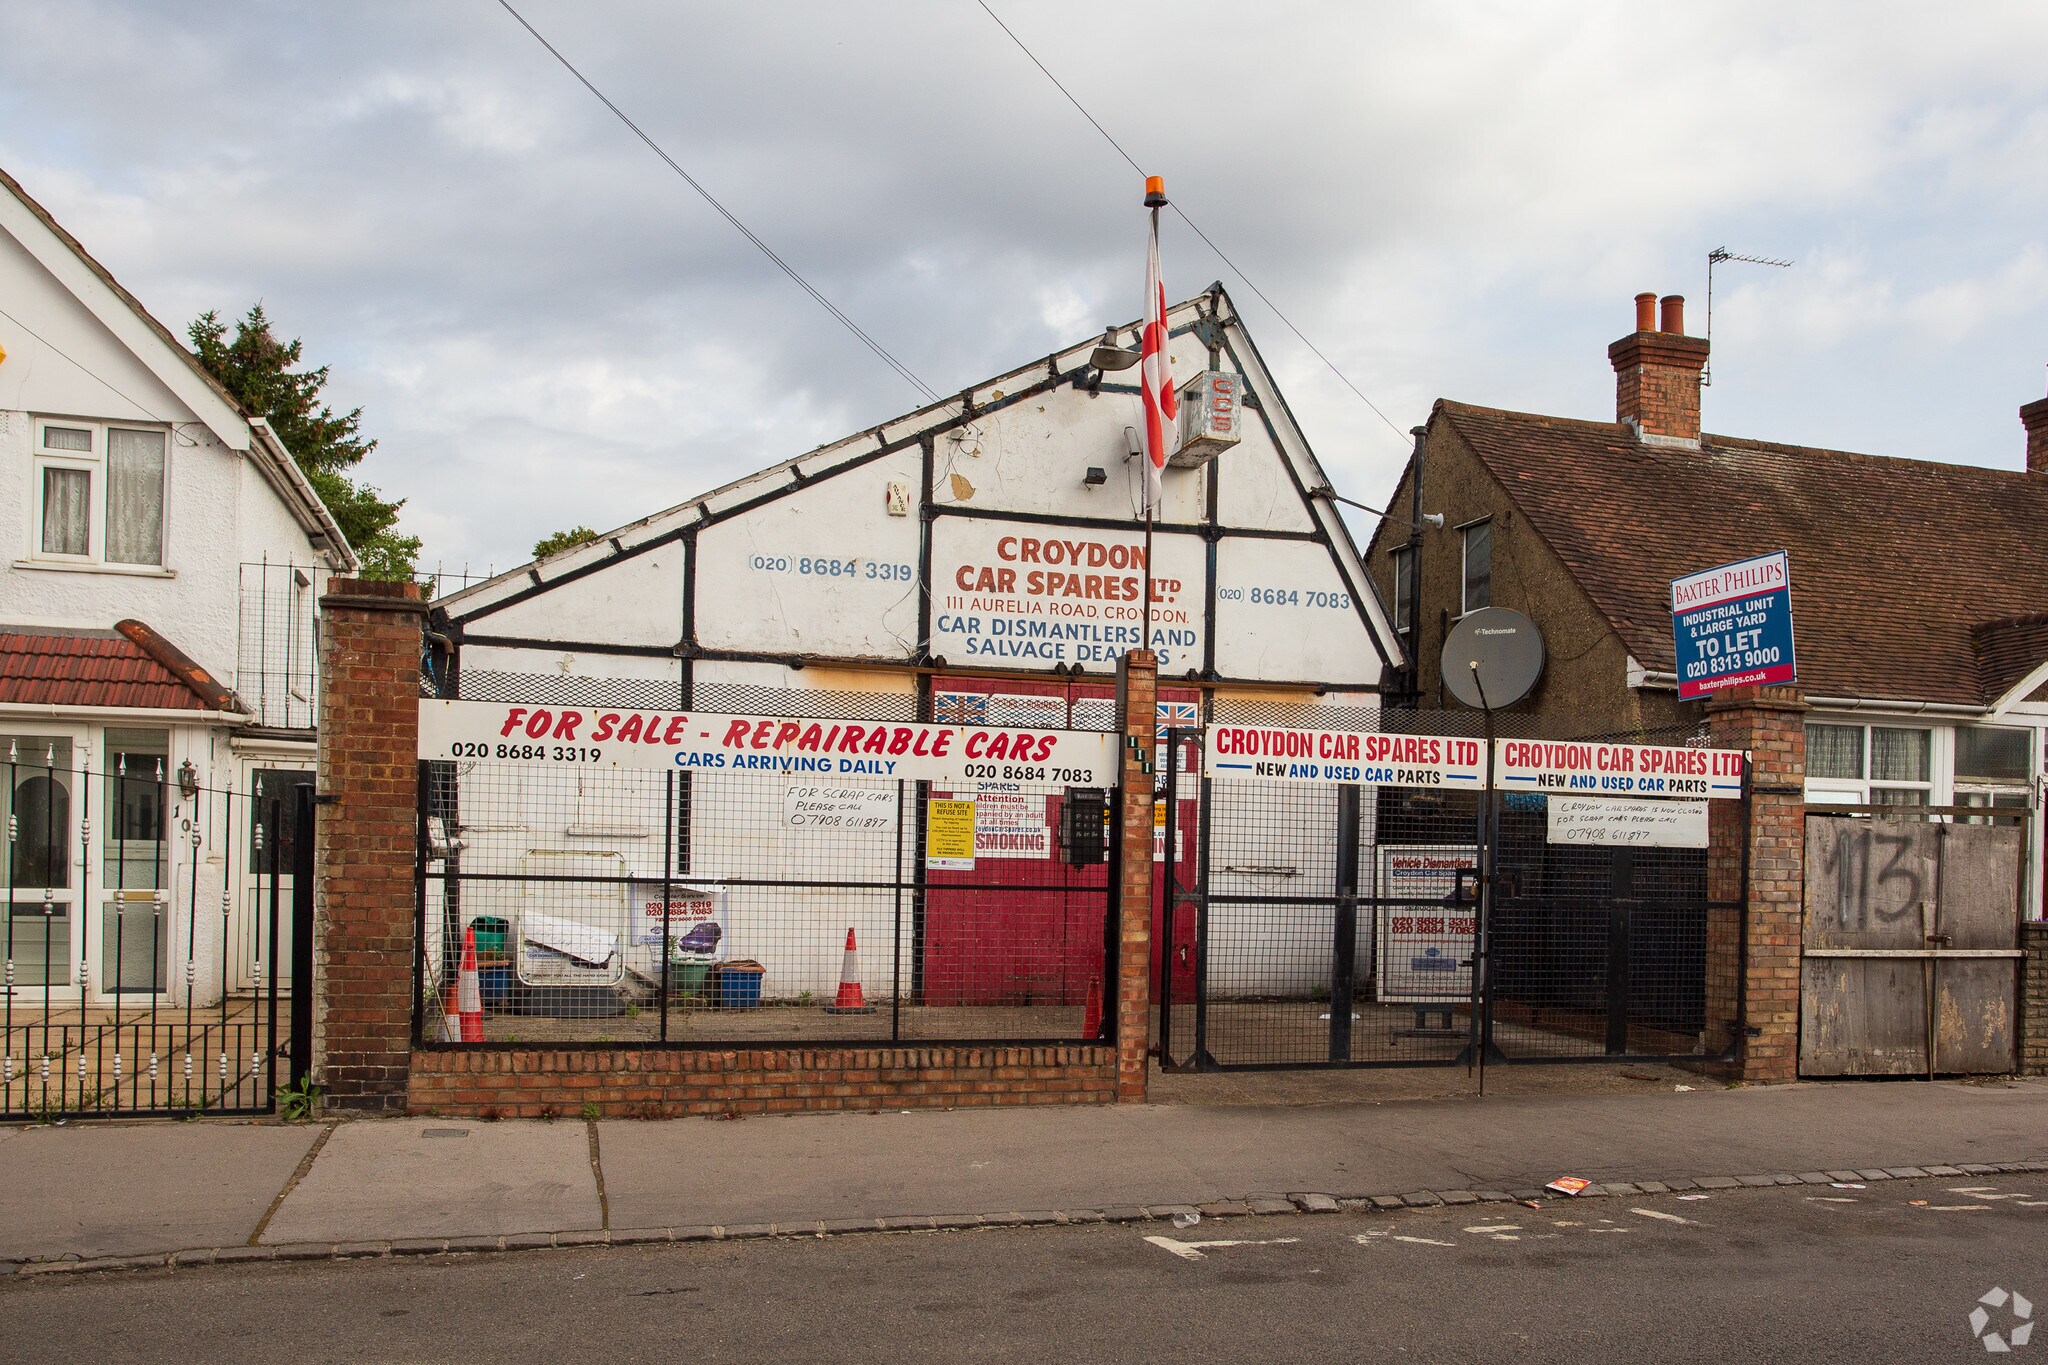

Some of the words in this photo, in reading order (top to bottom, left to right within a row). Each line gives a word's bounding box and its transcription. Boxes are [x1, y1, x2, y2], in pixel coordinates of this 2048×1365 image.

[997, 536, 1146, 570] CROYDON
[749, 553, 793, 574] (020)
[799, 557, 857, 578] 8684
[865, 562, 912, 582] 3319
[955, 565, 1017, 593] CAR
[1026, 570, 1139, 601] SPARES
[946, 595, 964, 610] 111
[970, 598, 1043, 615] AURELIA
[1050, 602, 1100, 619] ROAD,
[1216, 585, 1245, 603] (020)
[1250, 587, 1299, 606] 8684
[1305, 591, 1350, 609] 7083
[1683, 605, 1743, 627] INDUSTRIAL
[1746, 597, 1774, 613] UNIT
[937, 615, 981, 634] CAR
[992, 619, 1141, 644] DISMANTLERS
[1151, 629, 1197, 647] AND
[1690, 627, 1698, 638] &
[1700, 618, 1733, 636] LARGE
[1736, 612, 1767, 628] YARD
[966, 637, 1066, 660] SALVAGE
[1077, 644, 1170, 665] DEAS
[1696, 638, 1719, 659] TO
[1725, 628, 1762, 654] LET
[1687, 660, 1708, 678] 020
[1711, 653, 1741, 673] 8313
[1745, 646, 1779, 667] 9000
[1699, 672, 1766, 691] baxterphilips.co.uk
[500, 708, 583, 741] FOR
[591, 713, 688, 745] SALE
[722, 719, 954, 757] REPAIRABLE
[964, 731, 1058, 762] CARS
[1216, 727, 1313, 759] CROYDON
[1319, 733, 1360, 760] CAR
[1365, 736, 1441, 765] SPARES
[1446, 740, 1479, 766] LTD
[452, 742, 489, 758] 020
[496, 744, 546, 760] 8684
[552, 747, 601, 763] 3319
[674, 751, 726, 768] CARS
[732, 754, 832, 772] ARRIVING
[839, 759, 896, 775] DAILY
[1505, 742, 1592, 771] CROYDON
[1597, 746, 1634, 772] CAR
[1639, 749, 1707, 775] SPARES
[1712, 752, 1742, 776] LTD
[964, 763, 997, 779] 020
[1002, 765, 1046, 781] 8684
[1051, 768, 1093, 783] 7083
[1256, 761, 1287, 777] NEW
[1289, 764, 1318, 779] AND
[1324, 766, 1360, 781] USED
[1365, 768, 1394, 783] CAR
[1397, 769, 1441, 784] PARTS
[1538, 773, 1566, 788] NEW
[1569, 774, 1596, 789] AND
[1601, 776, 1634, 791] USED
[1638, 778, 1665, 791] CAR
[1669, 779, 1707, 793] PARTS
[787, 786, 819, 798] FOR
[822, 788, 865, 800] SCRAP
[866, 793, 895, 803] CARS
[795, 801, 836, 811] PLEASE
[838, 803, 862, 811] CALL
[976, 794, 1024, 803] Attention
[1561, 802, 1602, 812] CROYDON
[790, 814, 842, 826] 07908
[845, 816, 888, 828] 611897
[976, 826, 1041, 834] roydonCarSpares.co.uk
[1557, 815, 1574, 826] FOR
[975, 832, 1045, 851] SMOKING
[1567, 828, 1606, 840] 07908
[1611, 830, 1650, 841] 611897
[1392, 857, 1421, 868] Vehicle
[1423, 857, 1472, 869] Dismantlers
[1824, 829, 1920, 929] 113
[1392, 917, 1414, 926] 020
[1417, 917, 1445, 926] 8684
[1392, 926, 1414, 934] 020
[1417, 926, 1445, 934] 8684
